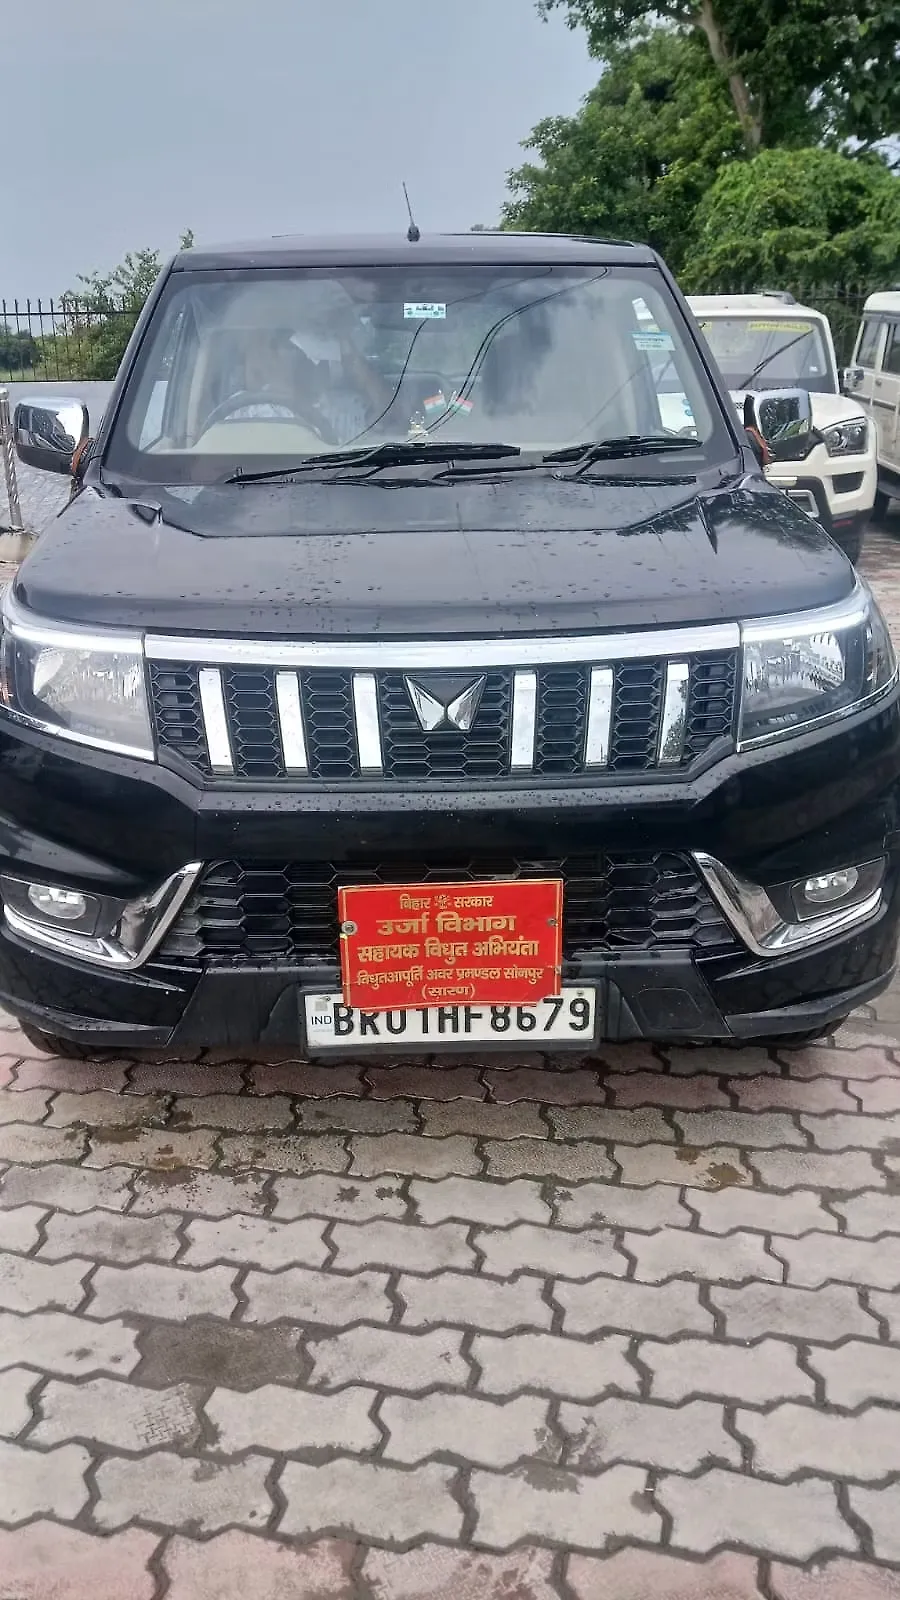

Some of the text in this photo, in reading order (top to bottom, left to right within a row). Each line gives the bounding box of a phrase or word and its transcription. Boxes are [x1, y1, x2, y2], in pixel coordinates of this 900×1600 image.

[399, 893, 494, 911] बिहार सरकार
[375, 910, 517, 935] उर्जा विभाग
[357, 943, 420, 962] सहायक
[472, 934, 540, 957] अभियंता
[426, 968, 454, 981] अवर
[455, 967, 502, 982] प्रमण्डल
[503, 963, 545, 985] सोनपुर
[311, 1015, 332, 1026] IND
